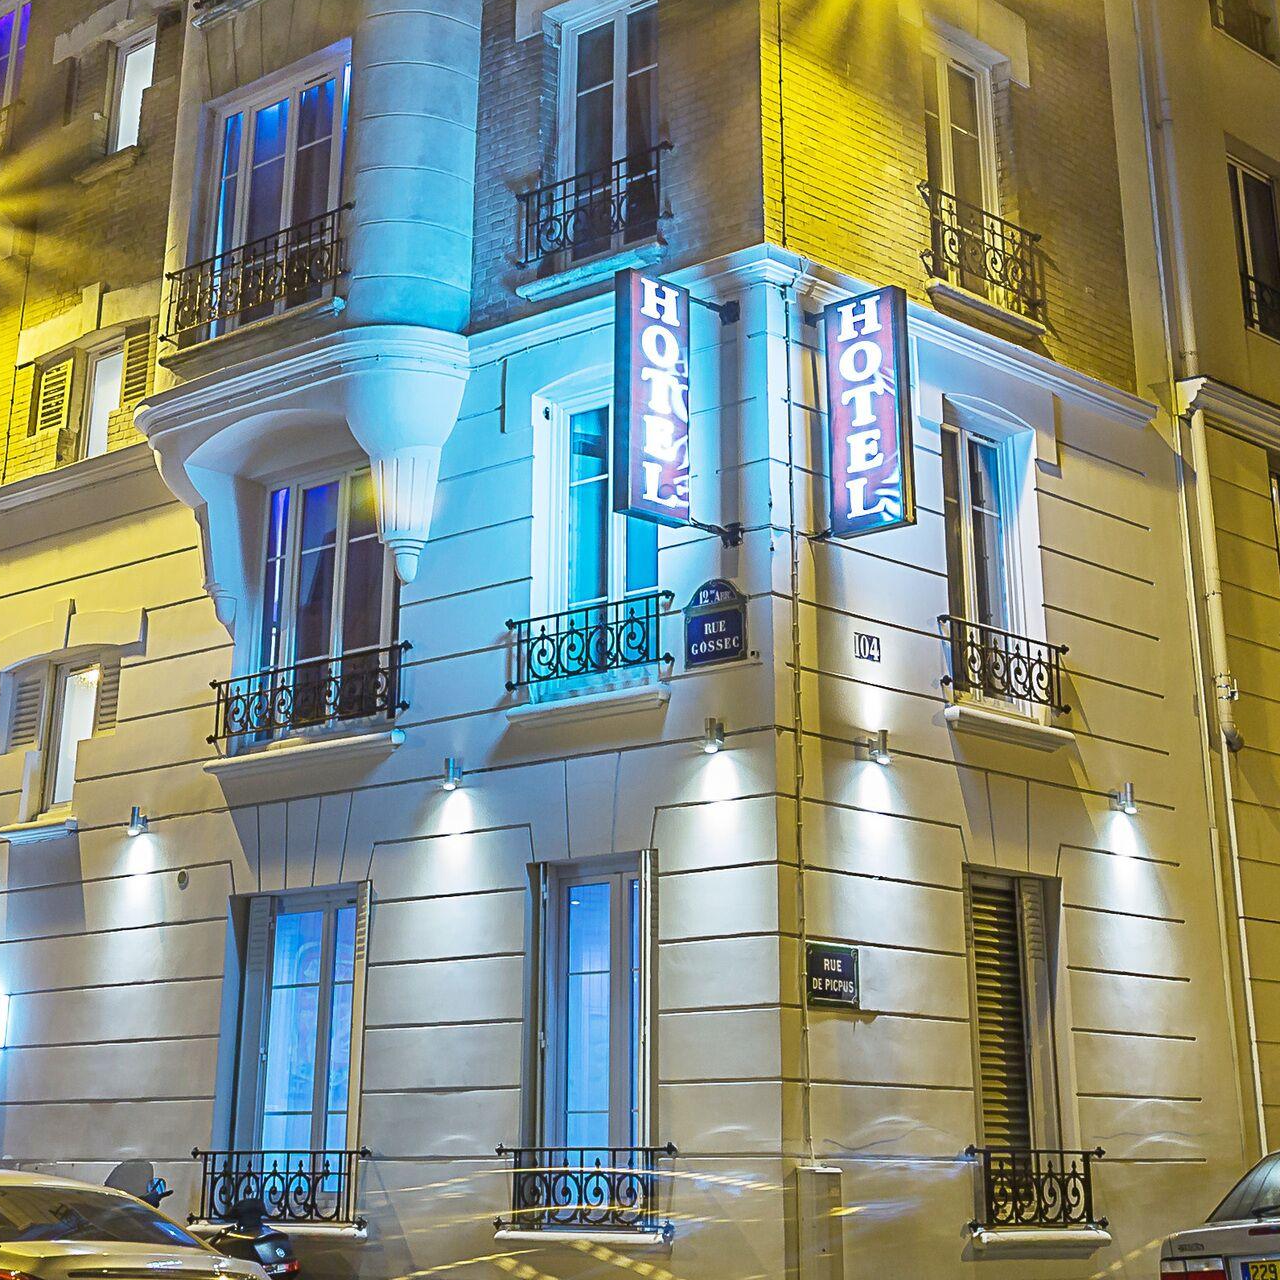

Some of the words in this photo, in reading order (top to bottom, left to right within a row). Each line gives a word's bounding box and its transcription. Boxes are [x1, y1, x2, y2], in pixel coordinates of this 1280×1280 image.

[640, 277, 683, 509] HOTEL
[836, 294, 886, 520] HOTEL
[704, 620, 726, 635] RUE
[691, 635, 740, 656] GOSSEC
[854, 634, 880, 661] 104
[823, 958, 842, 972] RUE
[812, 977, 823, 990] DE
[825, 978, 854, 994] PICPUS
[1249, 1263, 1278, 1280] 229
